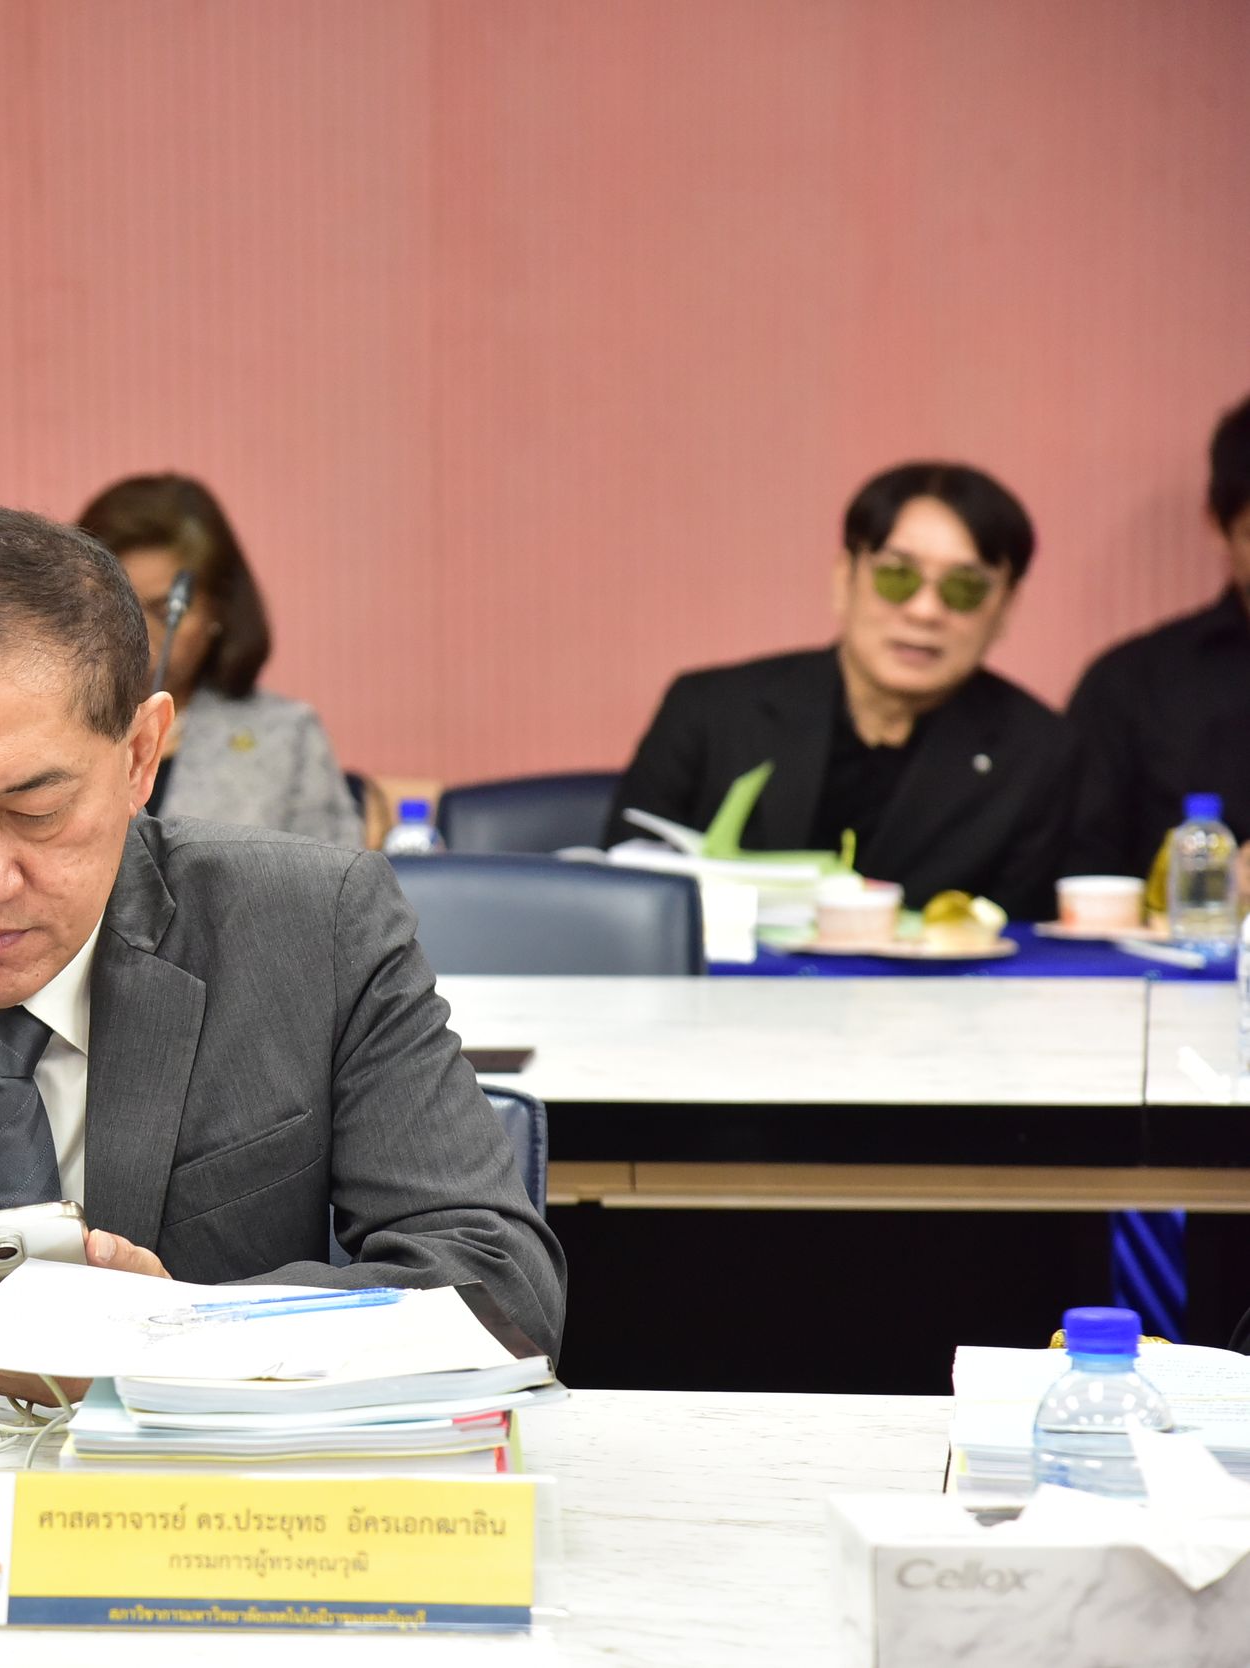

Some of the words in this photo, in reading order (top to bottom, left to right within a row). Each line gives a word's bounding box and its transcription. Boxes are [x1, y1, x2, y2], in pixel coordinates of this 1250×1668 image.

[38, 1502, 187, 1531] ศาสตราจารย์
[197, 1508, 327, 1540] ดร.ประยุทธ
[168, 1548, 369, 1578] กรรมการผู้ทรงคุณวุฒิ
